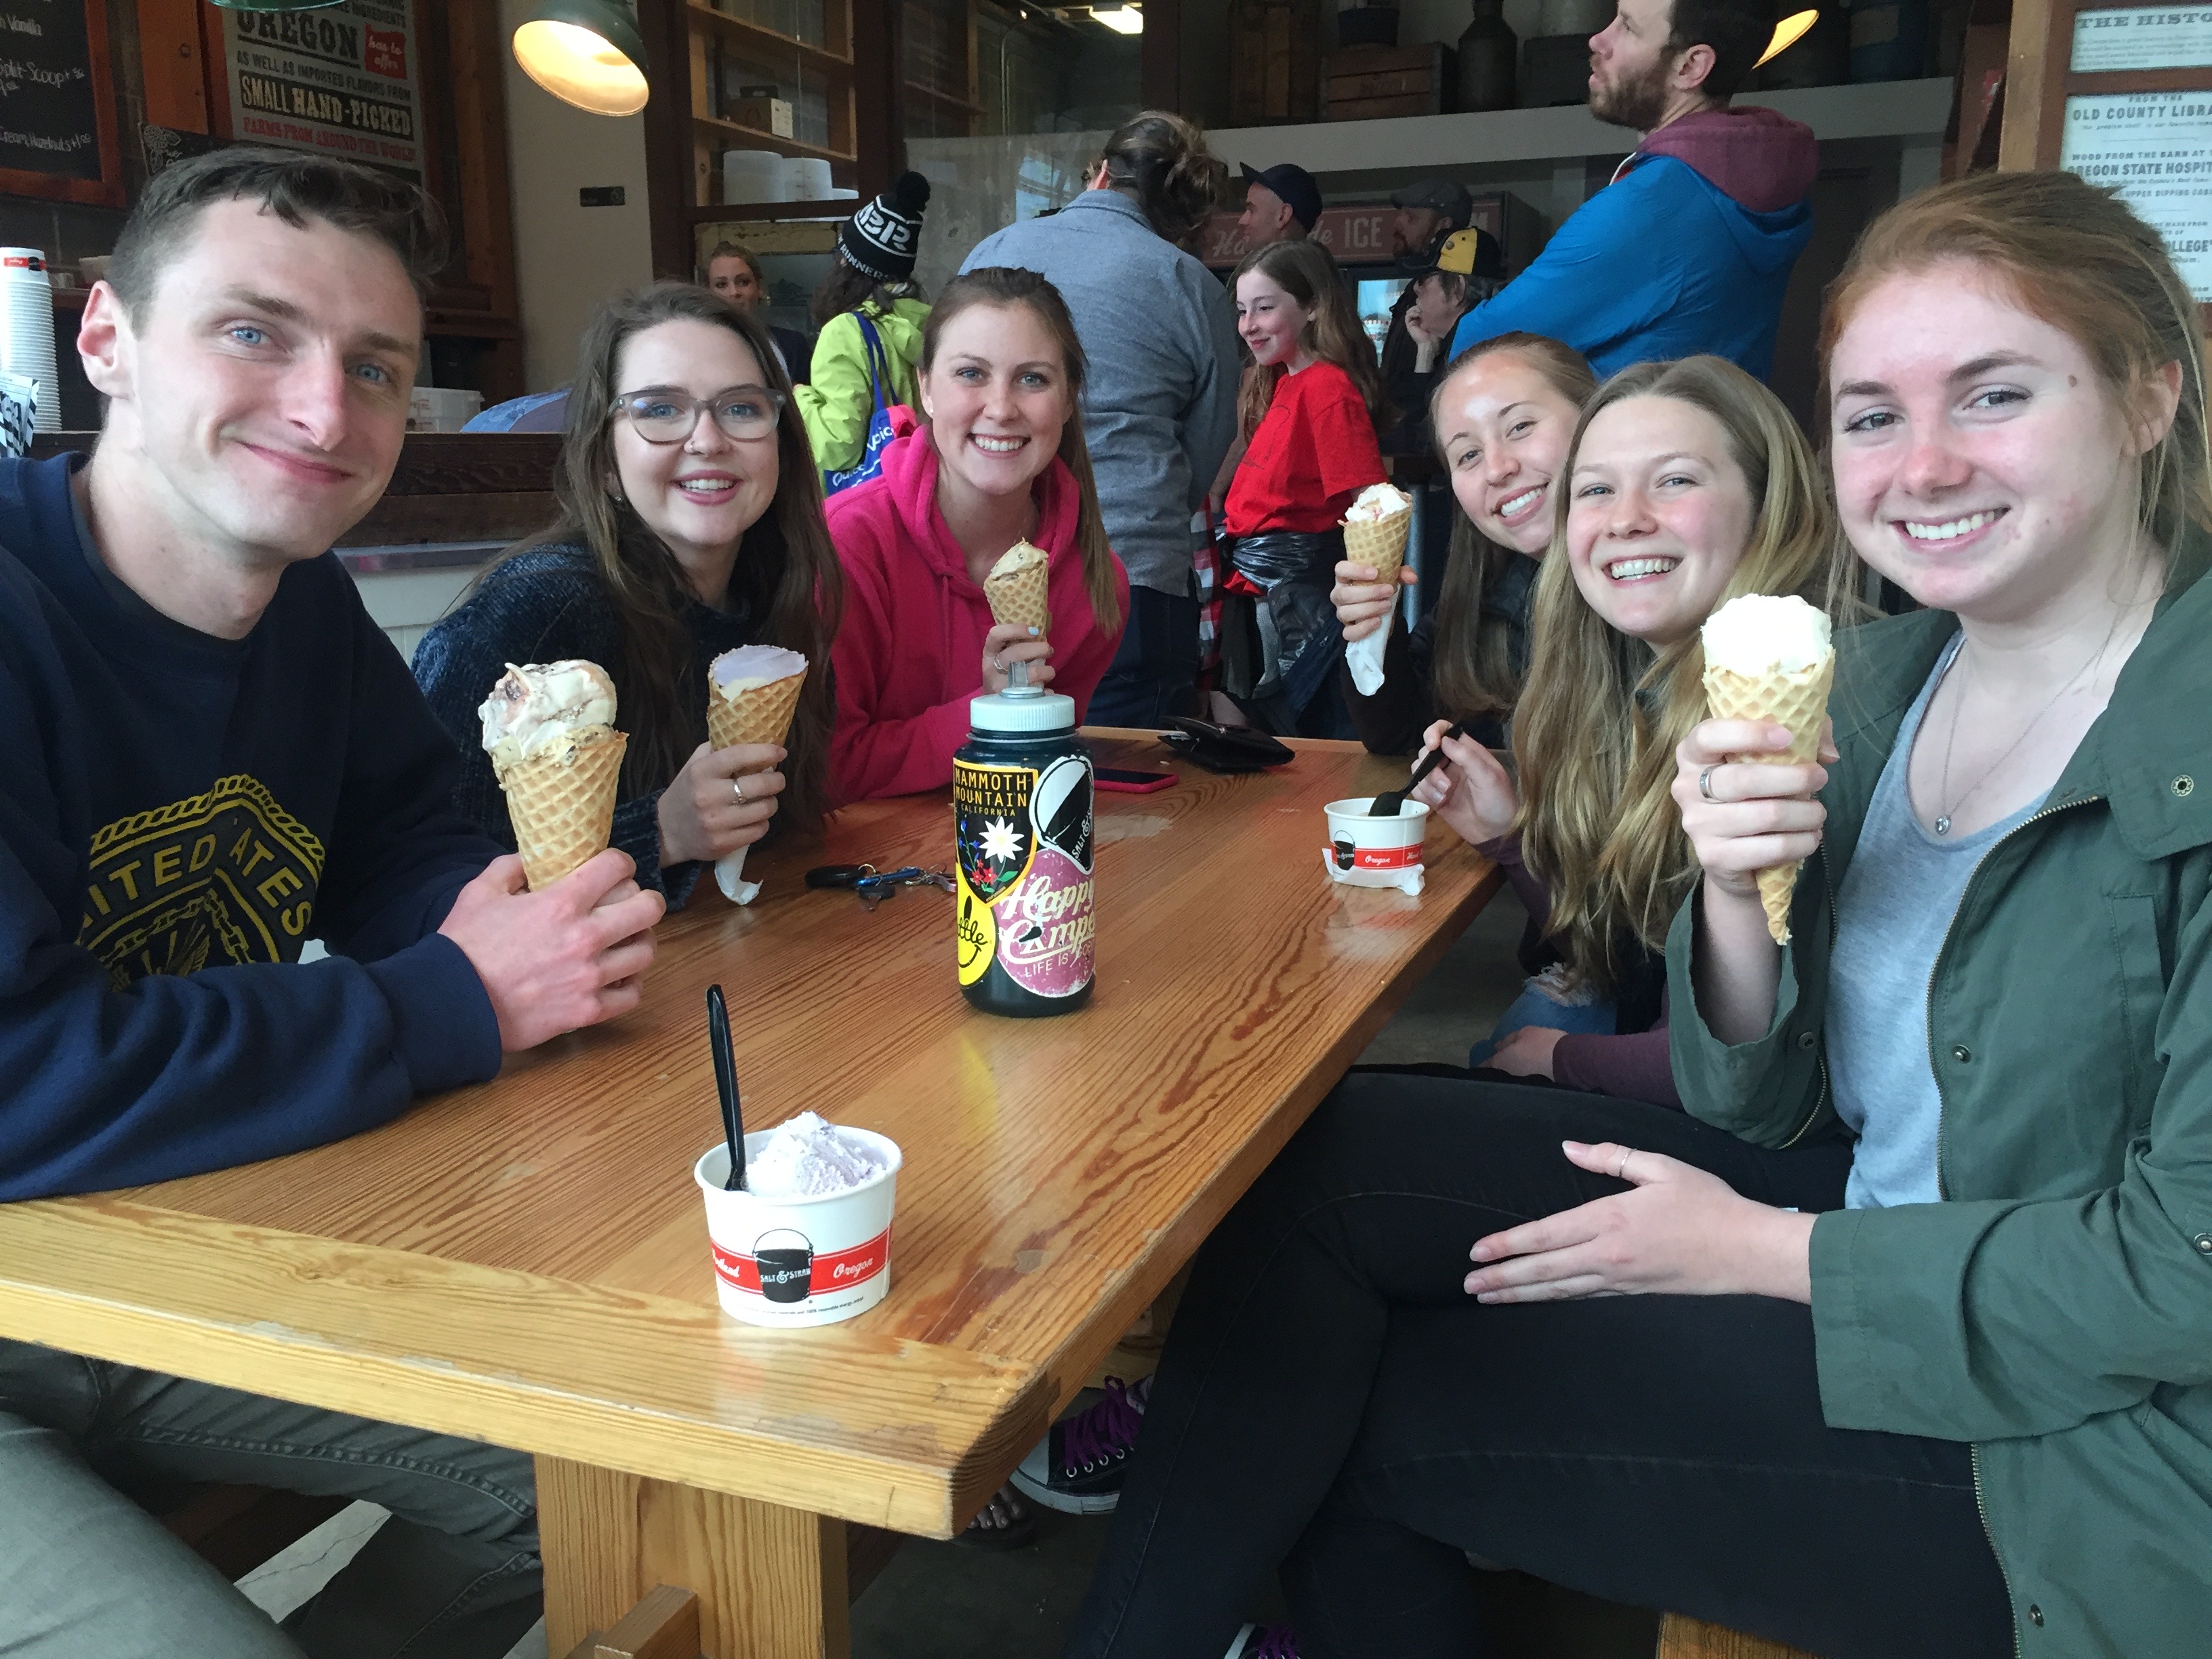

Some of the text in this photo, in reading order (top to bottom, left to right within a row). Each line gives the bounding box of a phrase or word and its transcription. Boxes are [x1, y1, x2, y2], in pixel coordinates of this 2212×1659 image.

[2077, 17, 2129, 28] THE
[237, 12, 359, 60] OREGON
[253, 52, 279, 73] WELL
[283, 61, 295, 76] AS
[298, 64, 344, 87] IMPORTED
[386, 85, 411, 100] FROM
[241, 75, 291, 113] SMALL
[2073, 109, 2100, 120] OLD
[2106, 106, 2166, 119] COUNTY
[2105, 152, 2134, 160] FROM
[2122, 163, 2163, 176] STATE
[1344, 217, 1383, 249] ICE
[955, 767, 1027, 791] MAMMOTH
[956, 785, 1027, 807] MOUNTAIN
[961, 804, 1015, 817] CALIFORNIA
[1365, 855, 1390, 866] Oregon
[1025, 952, 1069, 978] LIFE IS
[760, 1273, 776, 1283] SALT
[776, 1270, 790, 1284] &
[833, 1257, 874, 1279] Oregon
